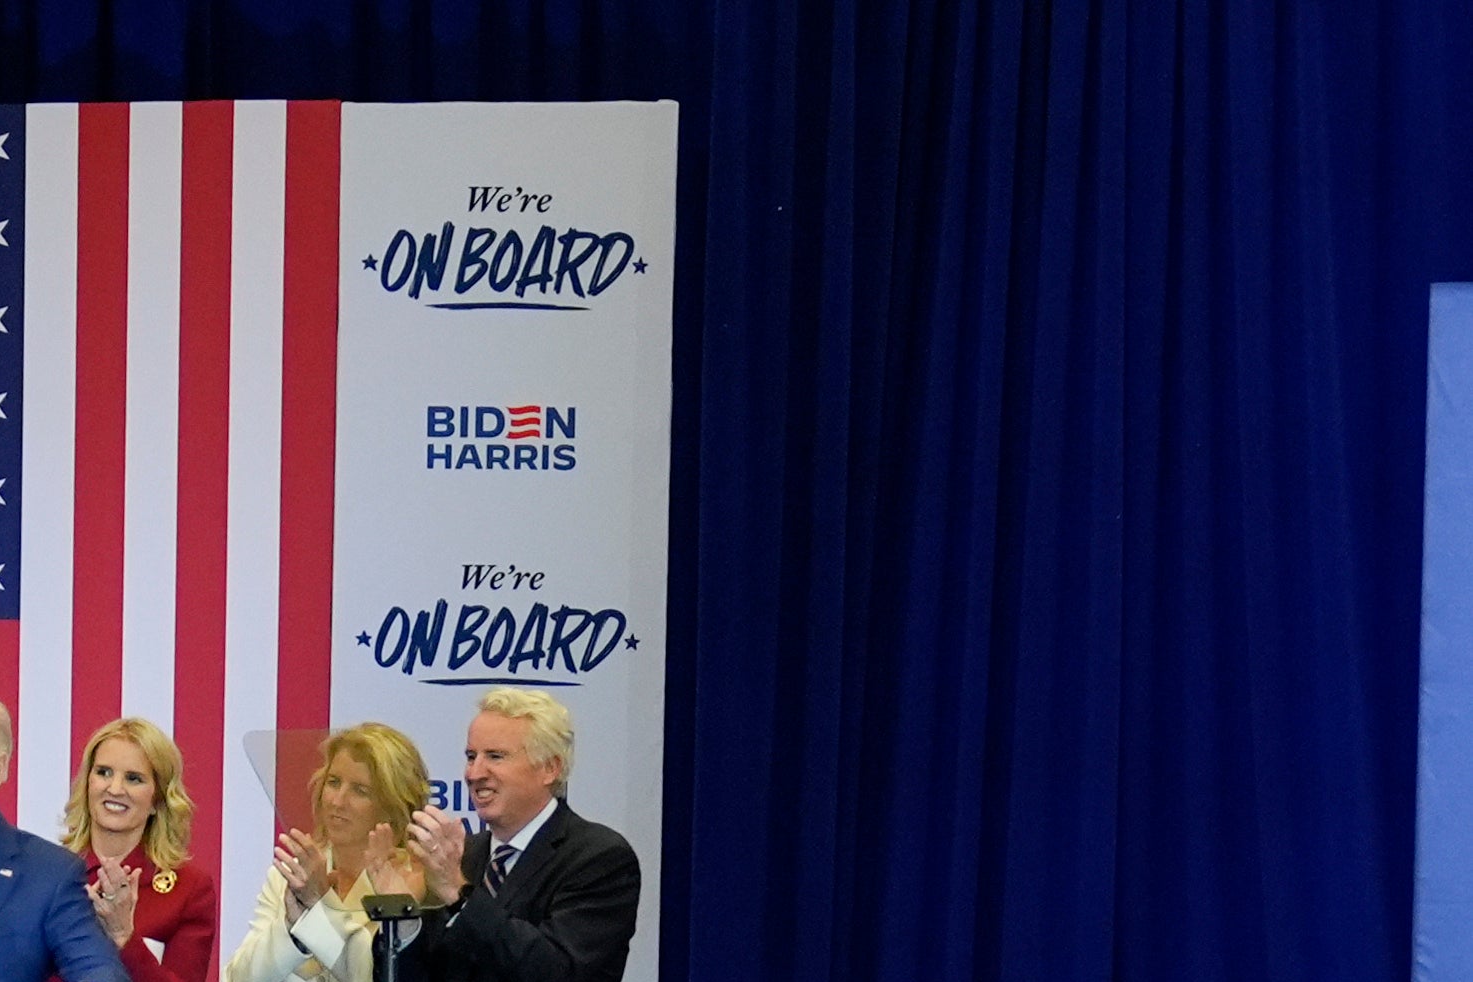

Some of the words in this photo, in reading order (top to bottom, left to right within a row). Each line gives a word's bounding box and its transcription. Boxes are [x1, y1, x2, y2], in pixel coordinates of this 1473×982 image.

[467, 186, 553, 213] We're
[380, 221, 455, 300] ON
[454, 225, 635, 299] BOARD
[426, 405, 576, 439] BIDEN
[426, 444, 577, 471] HARRIS
[461, 564, 545, 591] We're
[375, 598, 448, 676] ON
[448, 603, 627, 674] BOARD
